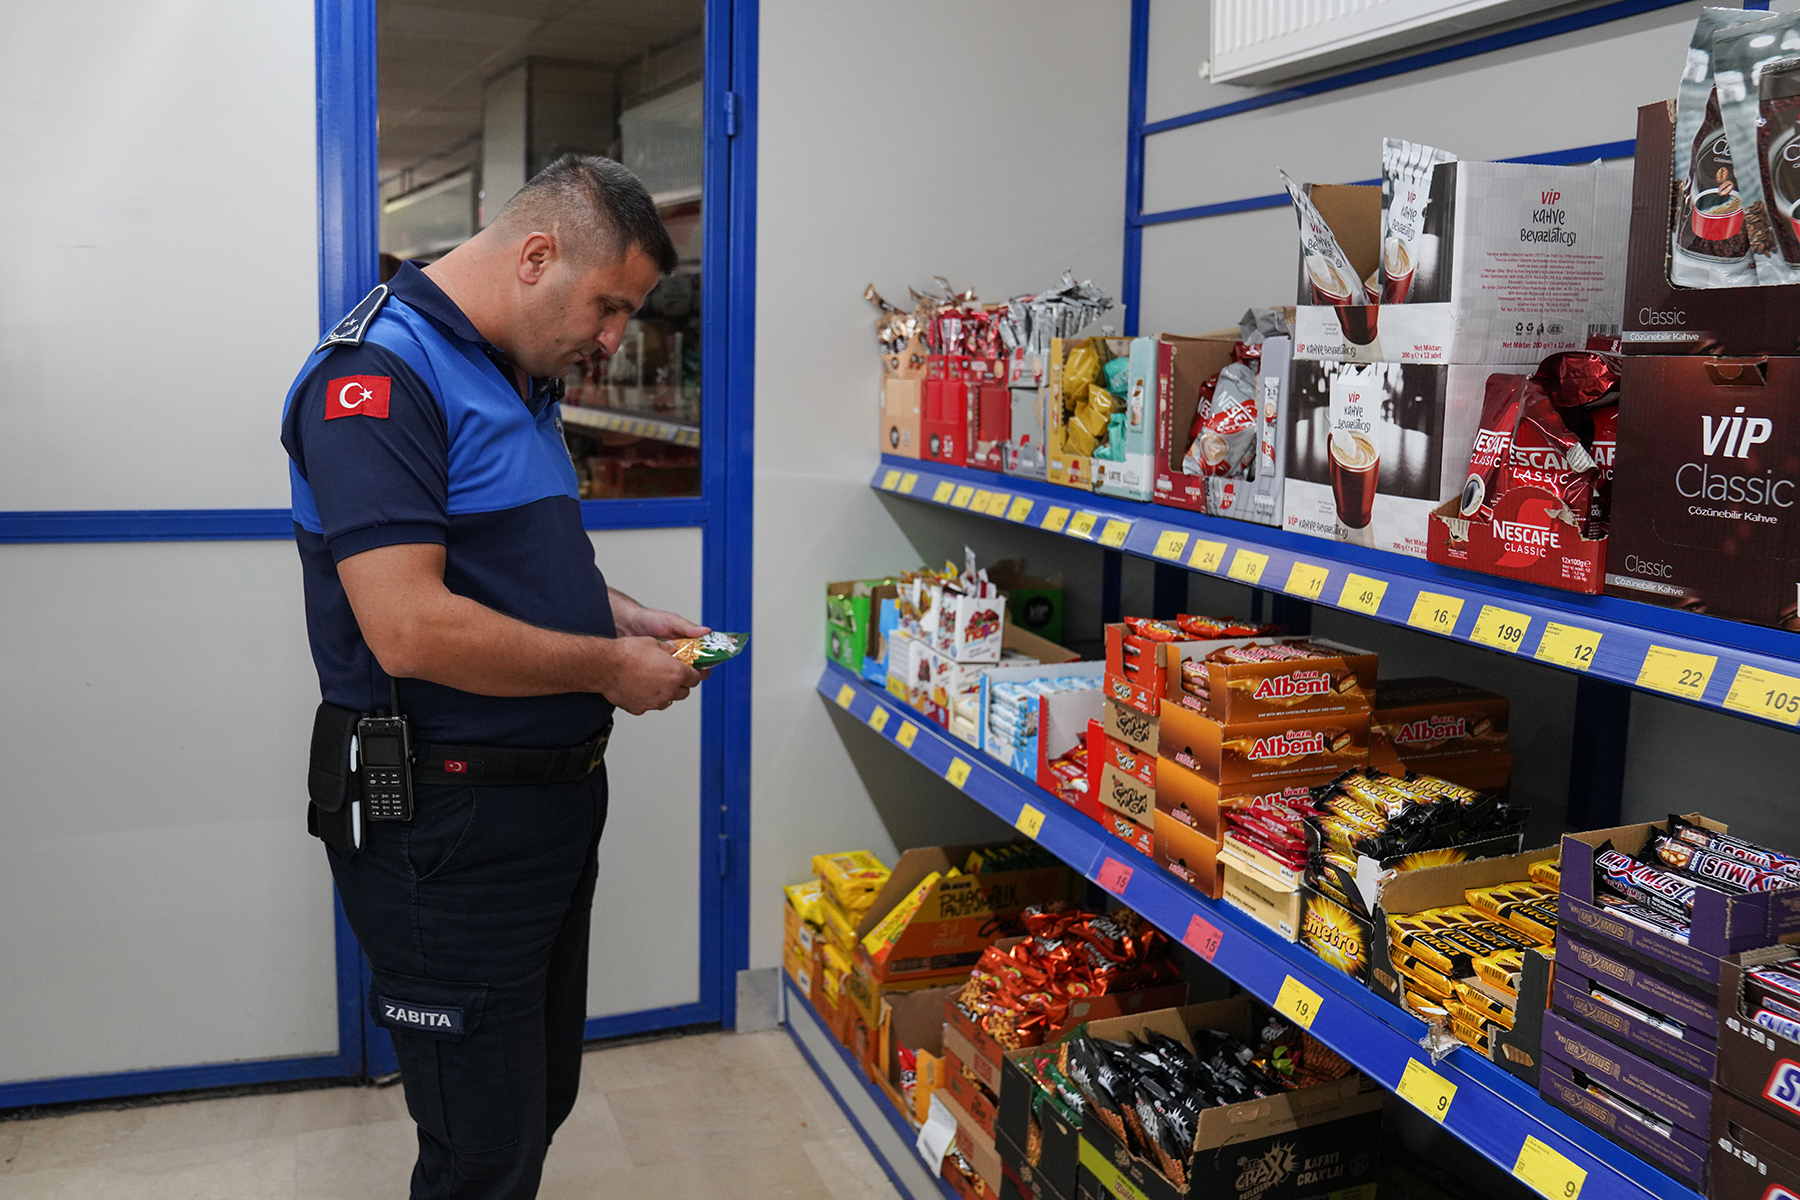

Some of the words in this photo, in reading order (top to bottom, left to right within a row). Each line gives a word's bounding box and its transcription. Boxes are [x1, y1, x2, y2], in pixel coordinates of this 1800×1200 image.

[1639, 307, 1685, 325] Classic
[1502, 341, 1512, 349] Net
[1513, 341, 1532, 349] Miktar:
[1673, 332, 1699, 341] Kahve
[1702, 406, 1772, 459] VİP
[1676, 463, 1795, 508] Classic
[1688, 505, 1742, 520] Çözünebilir
[1744, 512, 1778, 524] Kahve
[1504, 543, 1546, 558] CLASSIC
[1625, 554, 1672, 578] Classic
[1614, 576, 1656, 593] Çözünebilir
[1657, 583, 1684, 596] Kahve
[1497, 624, 1522, 643] 199
[1574, 644, 1593, 662] 12
[1254, 673, 1331, 699] Albeni
[1293, 670, 1319, 680] ÜLKER
[1678, 669, 1703, 688] 22
[1765, 690, 1800, 713] 105
[1286, 730, 1312, 741] ÜLKER
[1395, 717, 1466, 744] Albeni
[1248, 733, 1324, 760] Albeni
[1284, 787, 1309, 797] ÜLKER
[1333, 797, 1386, 825] metro
[1116, 875, 1127, 888] 15
[1599, 852, 1684, 898] MAXIMUS
[1578, 908, 1627, 941] MAXIMUS
[1205, 937, 1218, 953] 15
[1306, 918, 1359, 955] metro
[1578, 947, 1628, 982] MAXIMUS
[385, 1004, 451, 1027] ZABITA
[1573, 996, 1623, 1032] MAXIMUS
[1725, 1016, 1740, 1032] 40
[1740, 1025, 1749, 1037] x
[1749, 1027, 1766, 1045] 50
[1766, 1038, 1775, 1052] g
[1565, 1040, 1614, 1075] MAXIMUS
[1775, 1068, 1800, 1107] S
[1437, 1096, 1448, 1111] 9
[1561, 1086, 1608, 1124] MAXIMUS
[1304, 1151, 1340, 1171] KAFAYI
[1717, 1137, 1733, 1154] 40
[1733, 1147, 1742, 1159] x
[1741, 1150, 1756, 1167] 50
[1756, 1160, 1767, 1175] g
[1297, 1166, 1344, 1187] CRAX'LA!
[1564, 1181, 1576, 1198] 9
